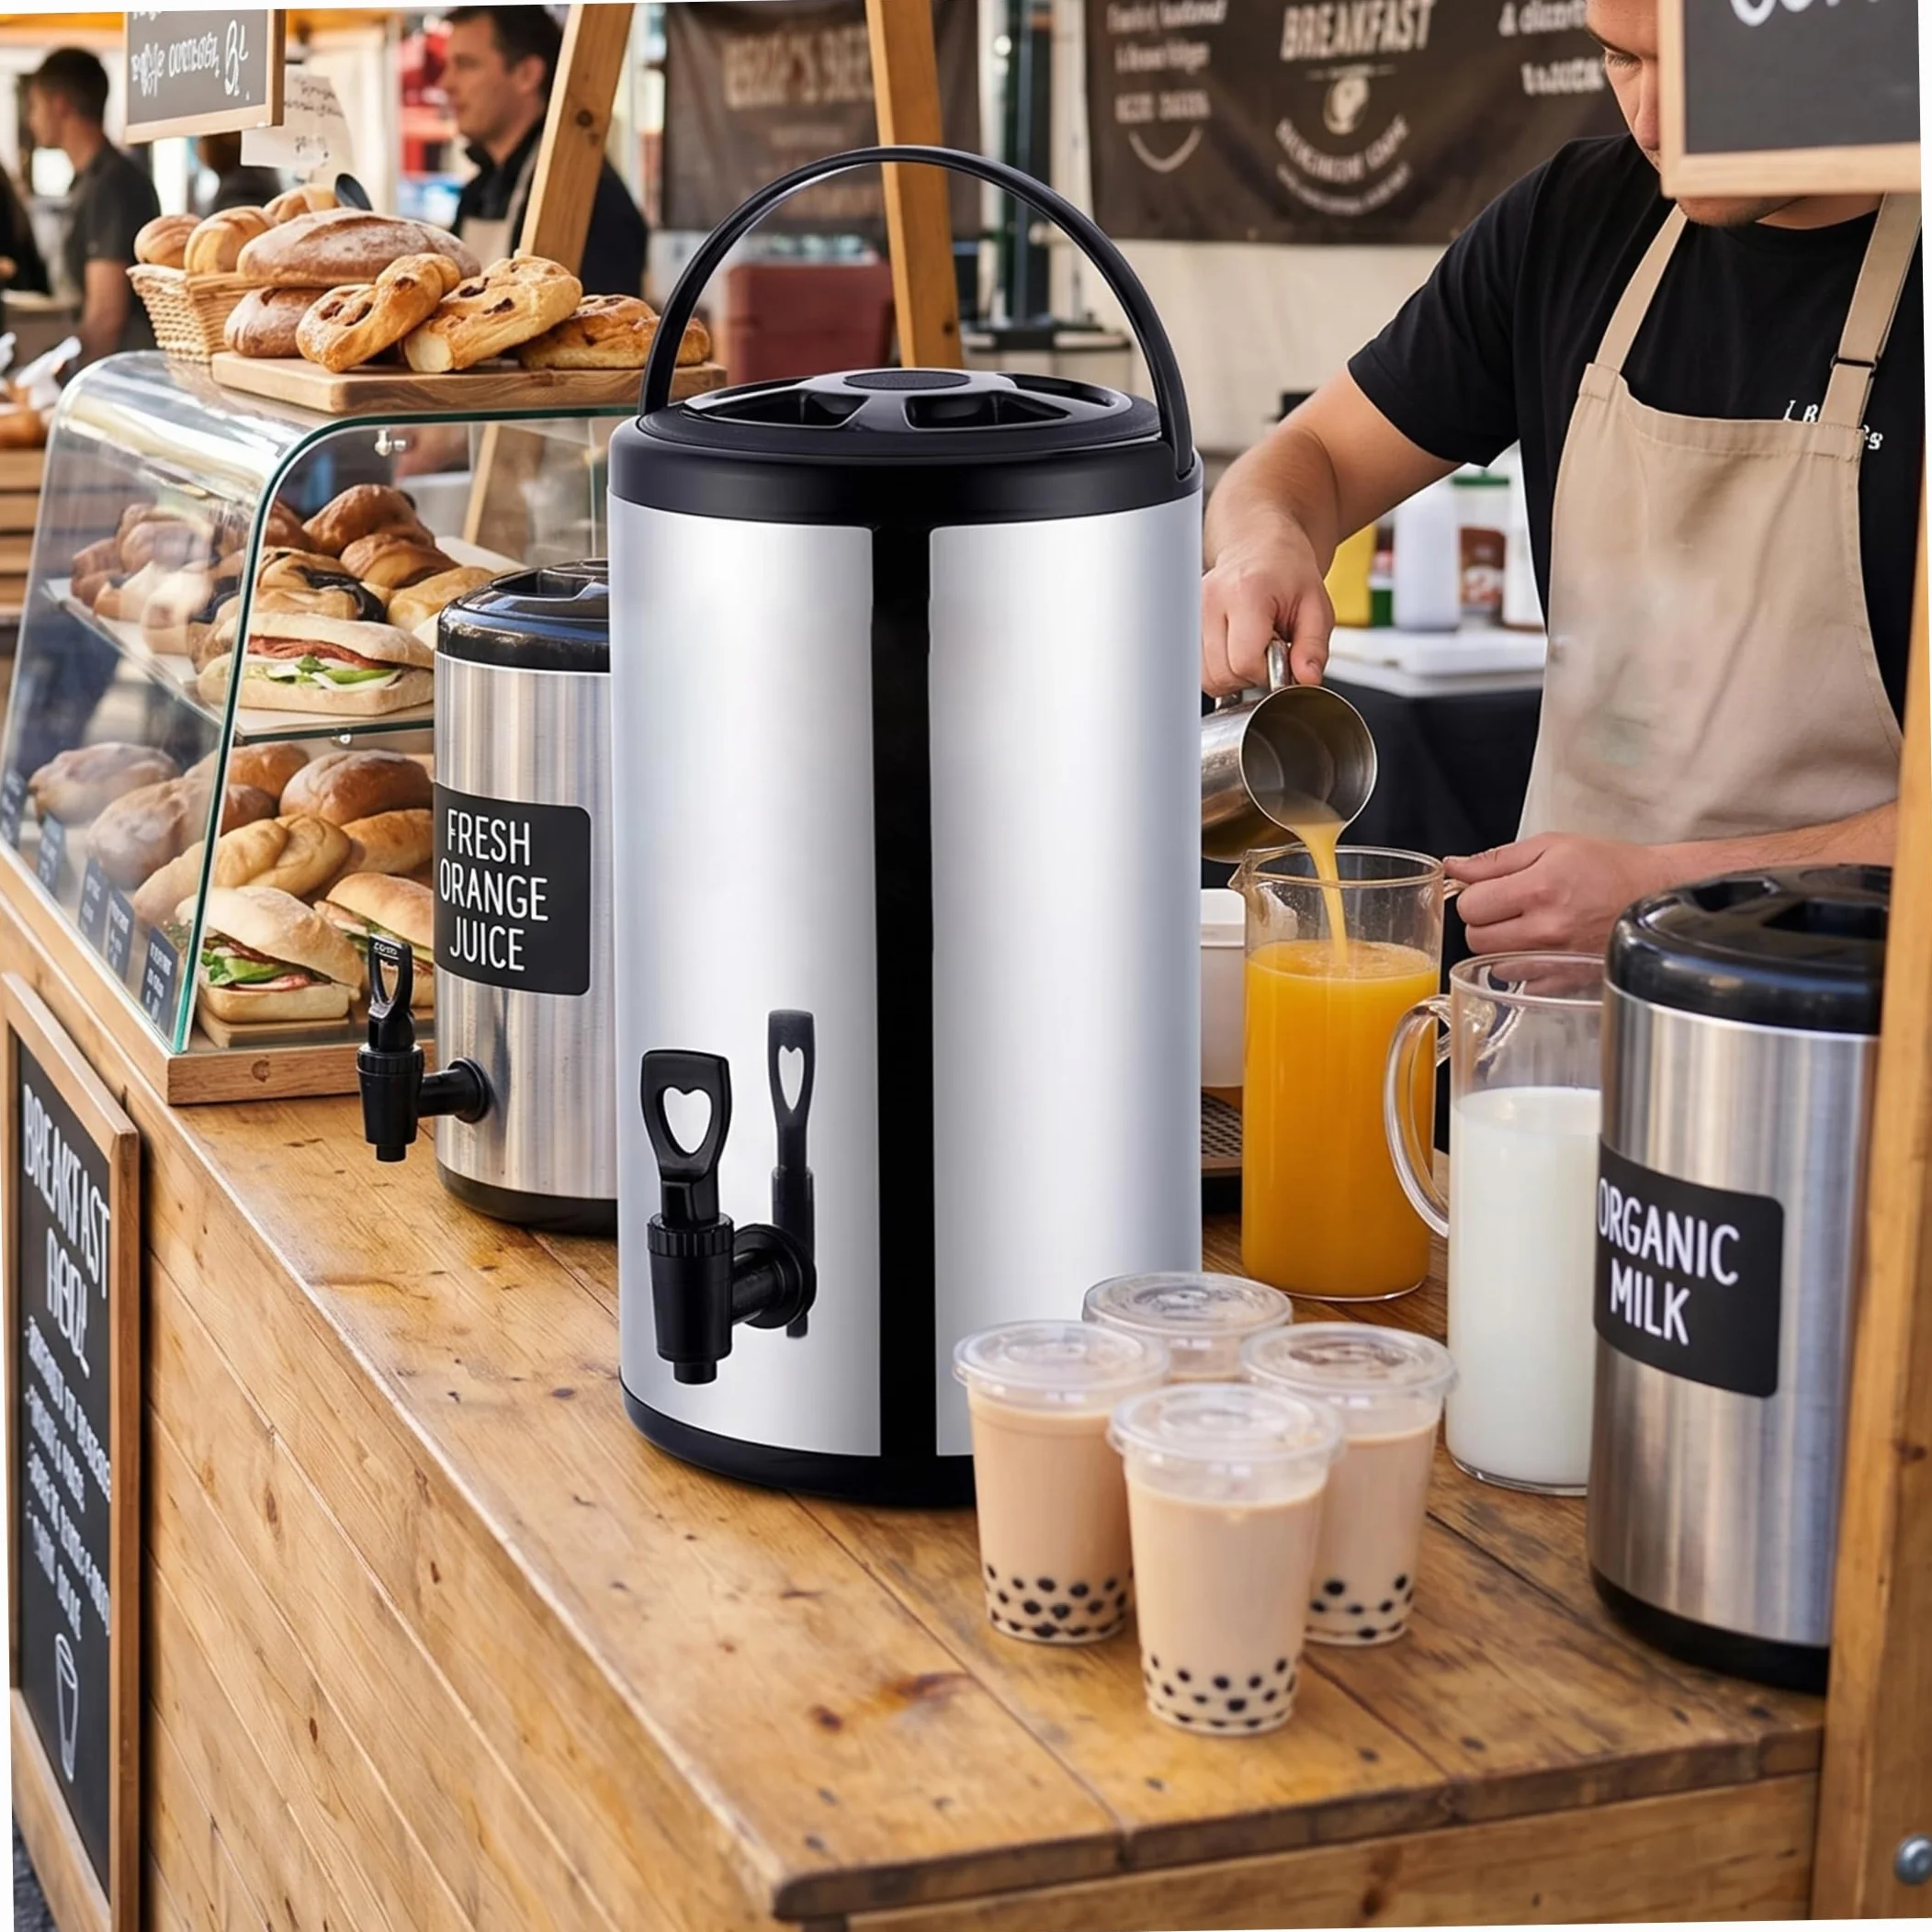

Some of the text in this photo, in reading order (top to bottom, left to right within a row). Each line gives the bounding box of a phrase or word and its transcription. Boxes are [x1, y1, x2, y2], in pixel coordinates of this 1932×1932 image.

[1280, 0, 1436, 61] BREAKFAST
[447, 808, 530, 865] FRESH
[440, 858, 548, 921] ORANGE
[449, 916, 525, 971] JUICE
[24, 1083, 109, 1300] BREAKFAST
[1598, 1177, 1740, 1286] ORGANIC
[1610, 1257, 1690, 1346] MILK
